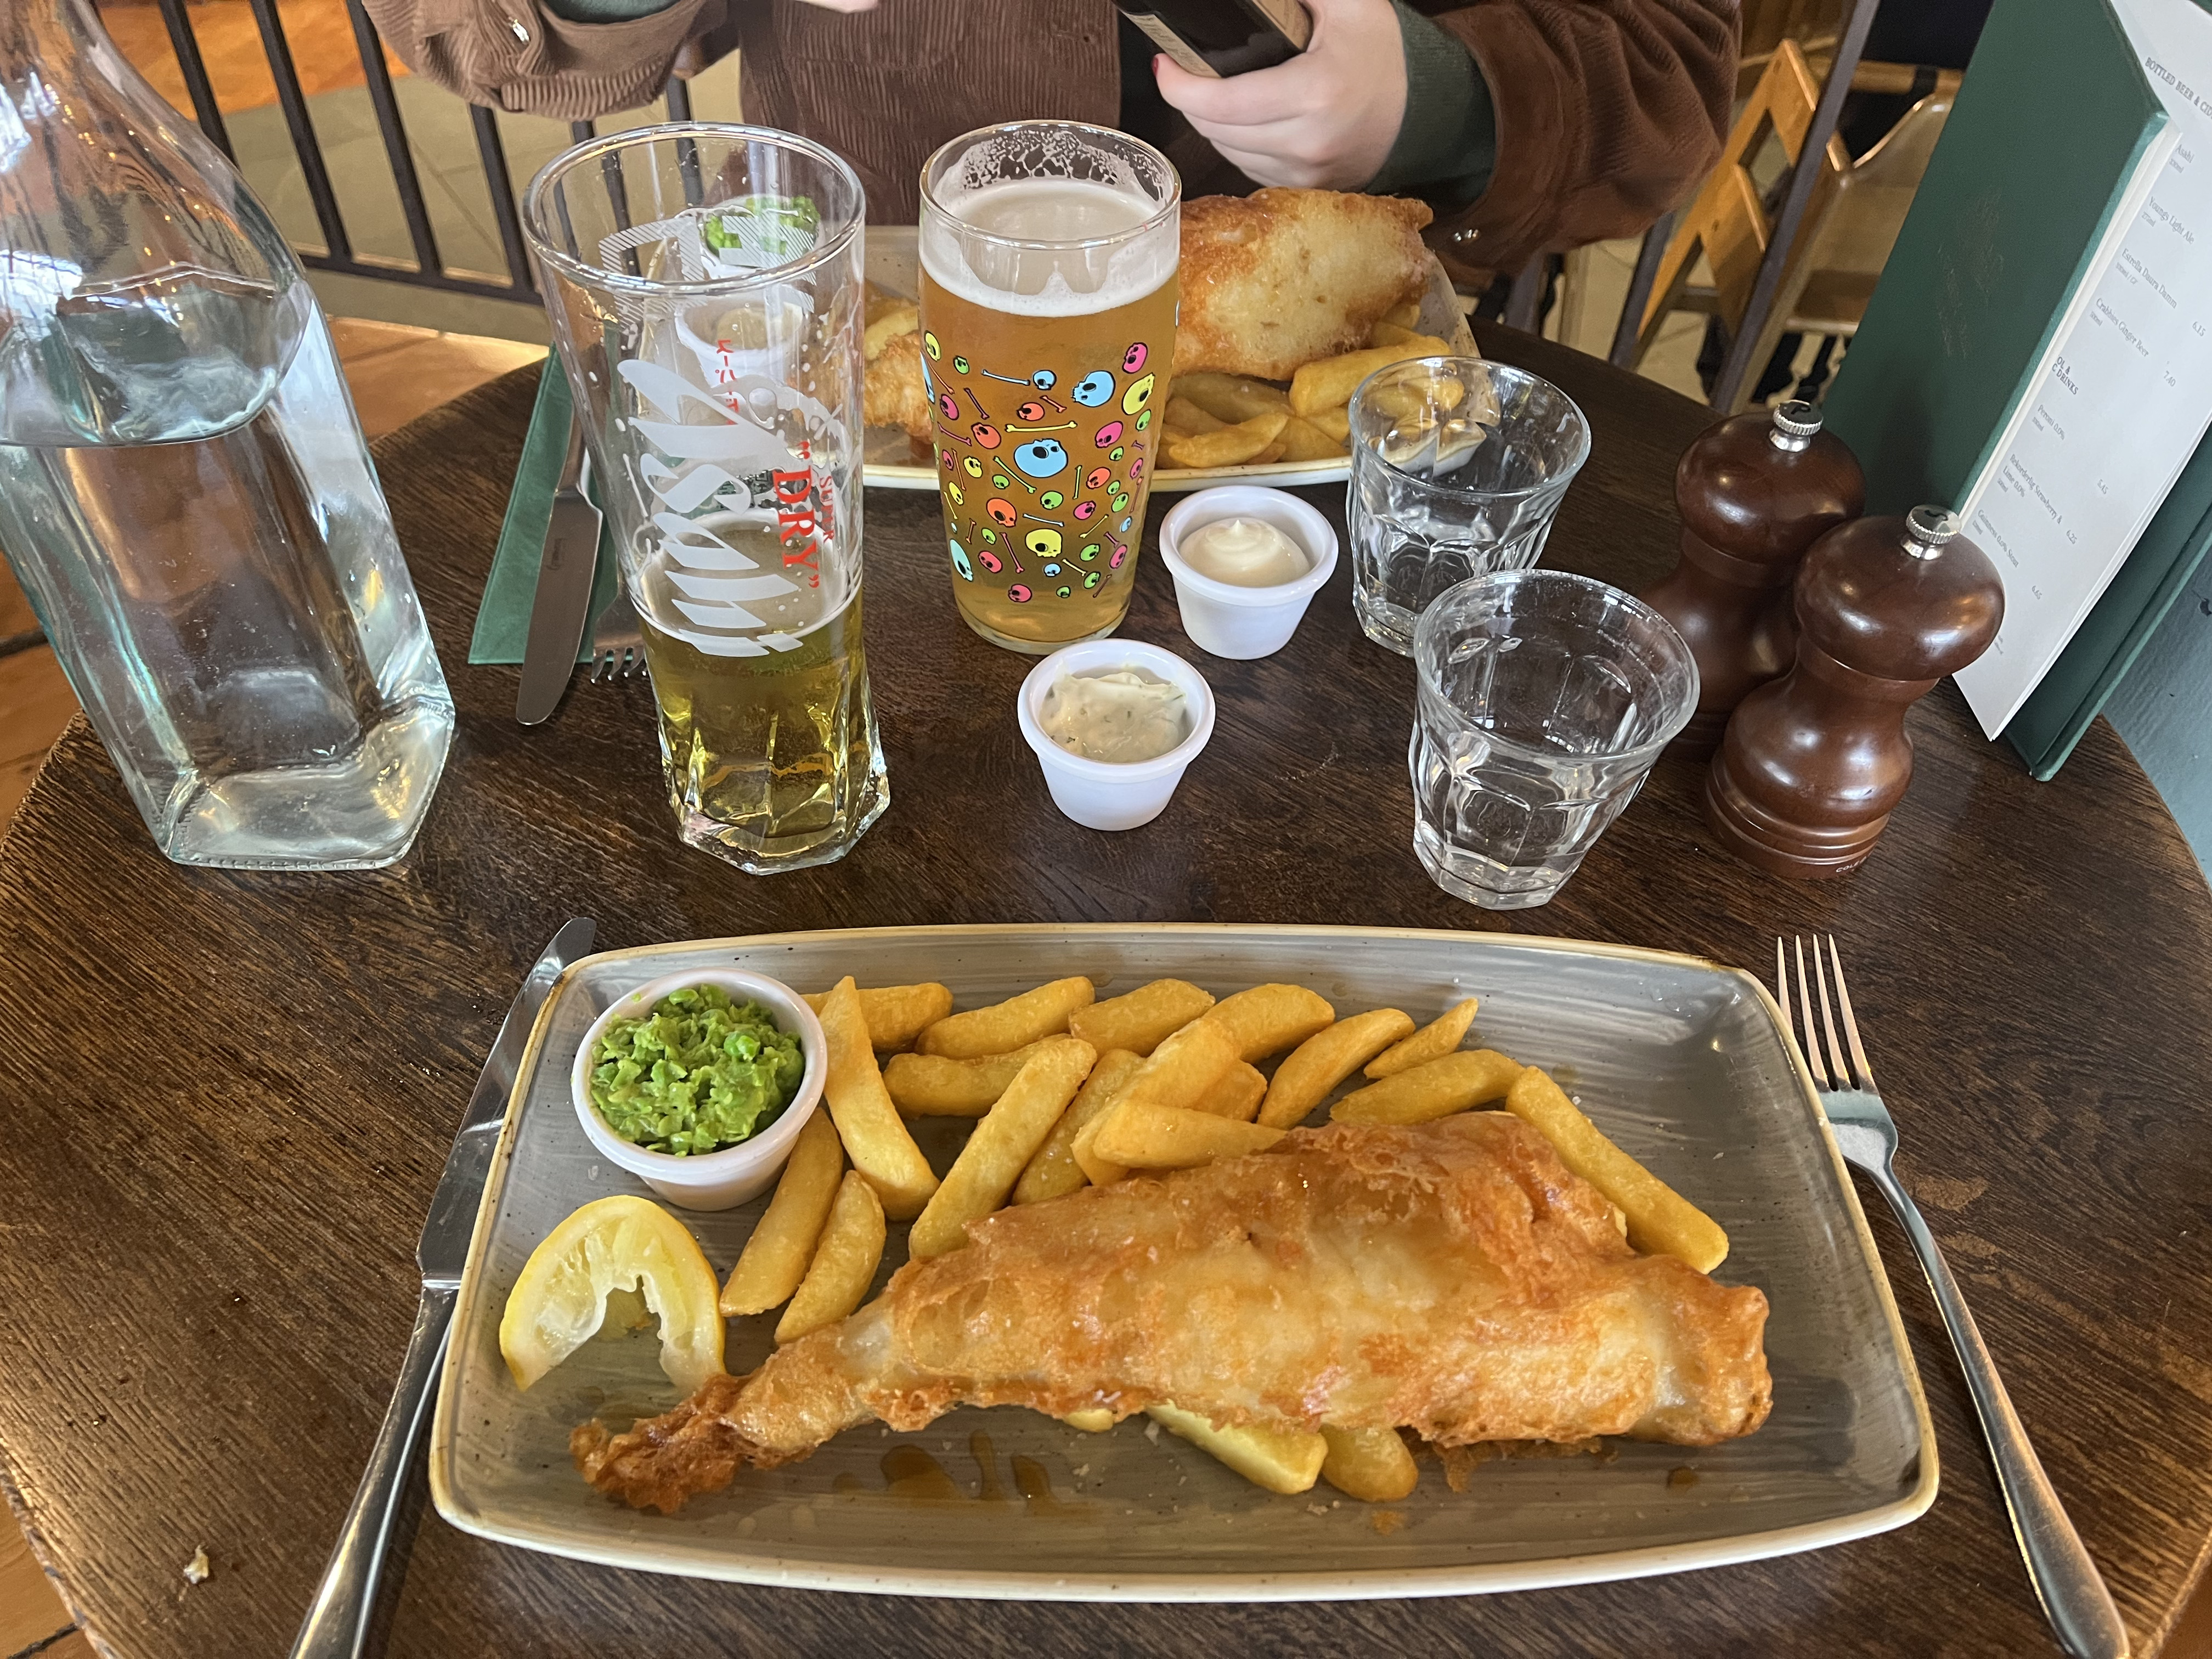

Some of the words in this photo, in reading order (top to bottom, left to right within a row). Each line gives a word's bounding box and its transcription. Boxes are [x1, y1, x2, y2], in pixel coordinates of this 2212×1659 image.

[2145, 57, 2176, 85] BOTTLED
[2175, 80, 2194, 101] BEER
[2200, 101, 2212, 120] CID
[2175, 144, 2194, 163] Asahi
[2149, 196, 2169, 221] Youngs
[2169, 215, 2185, 235] Light
[2183, 230, 2194, 245] Ale
[2121, 248, 2142, 273] Estrella
[2142, 267, 2159, 291] Daura
[2158, 284, 2177, 309] Damm
[2118, 321, 2137, 345] Ginger
[2136, 339, 2149, 357] Beer
[2056, 369, 2079, 395] DRINKS
[2038, 404, 2055, 427] Peroni
[2002, 465, 2015, 484] Lime
[617, 359, 803, 657] Asahi
[819, 475, 836, 544] SUPER
[2034, 484, 2058, 520] Strawberry
[1978, 509, 1998, 539] Guinness
